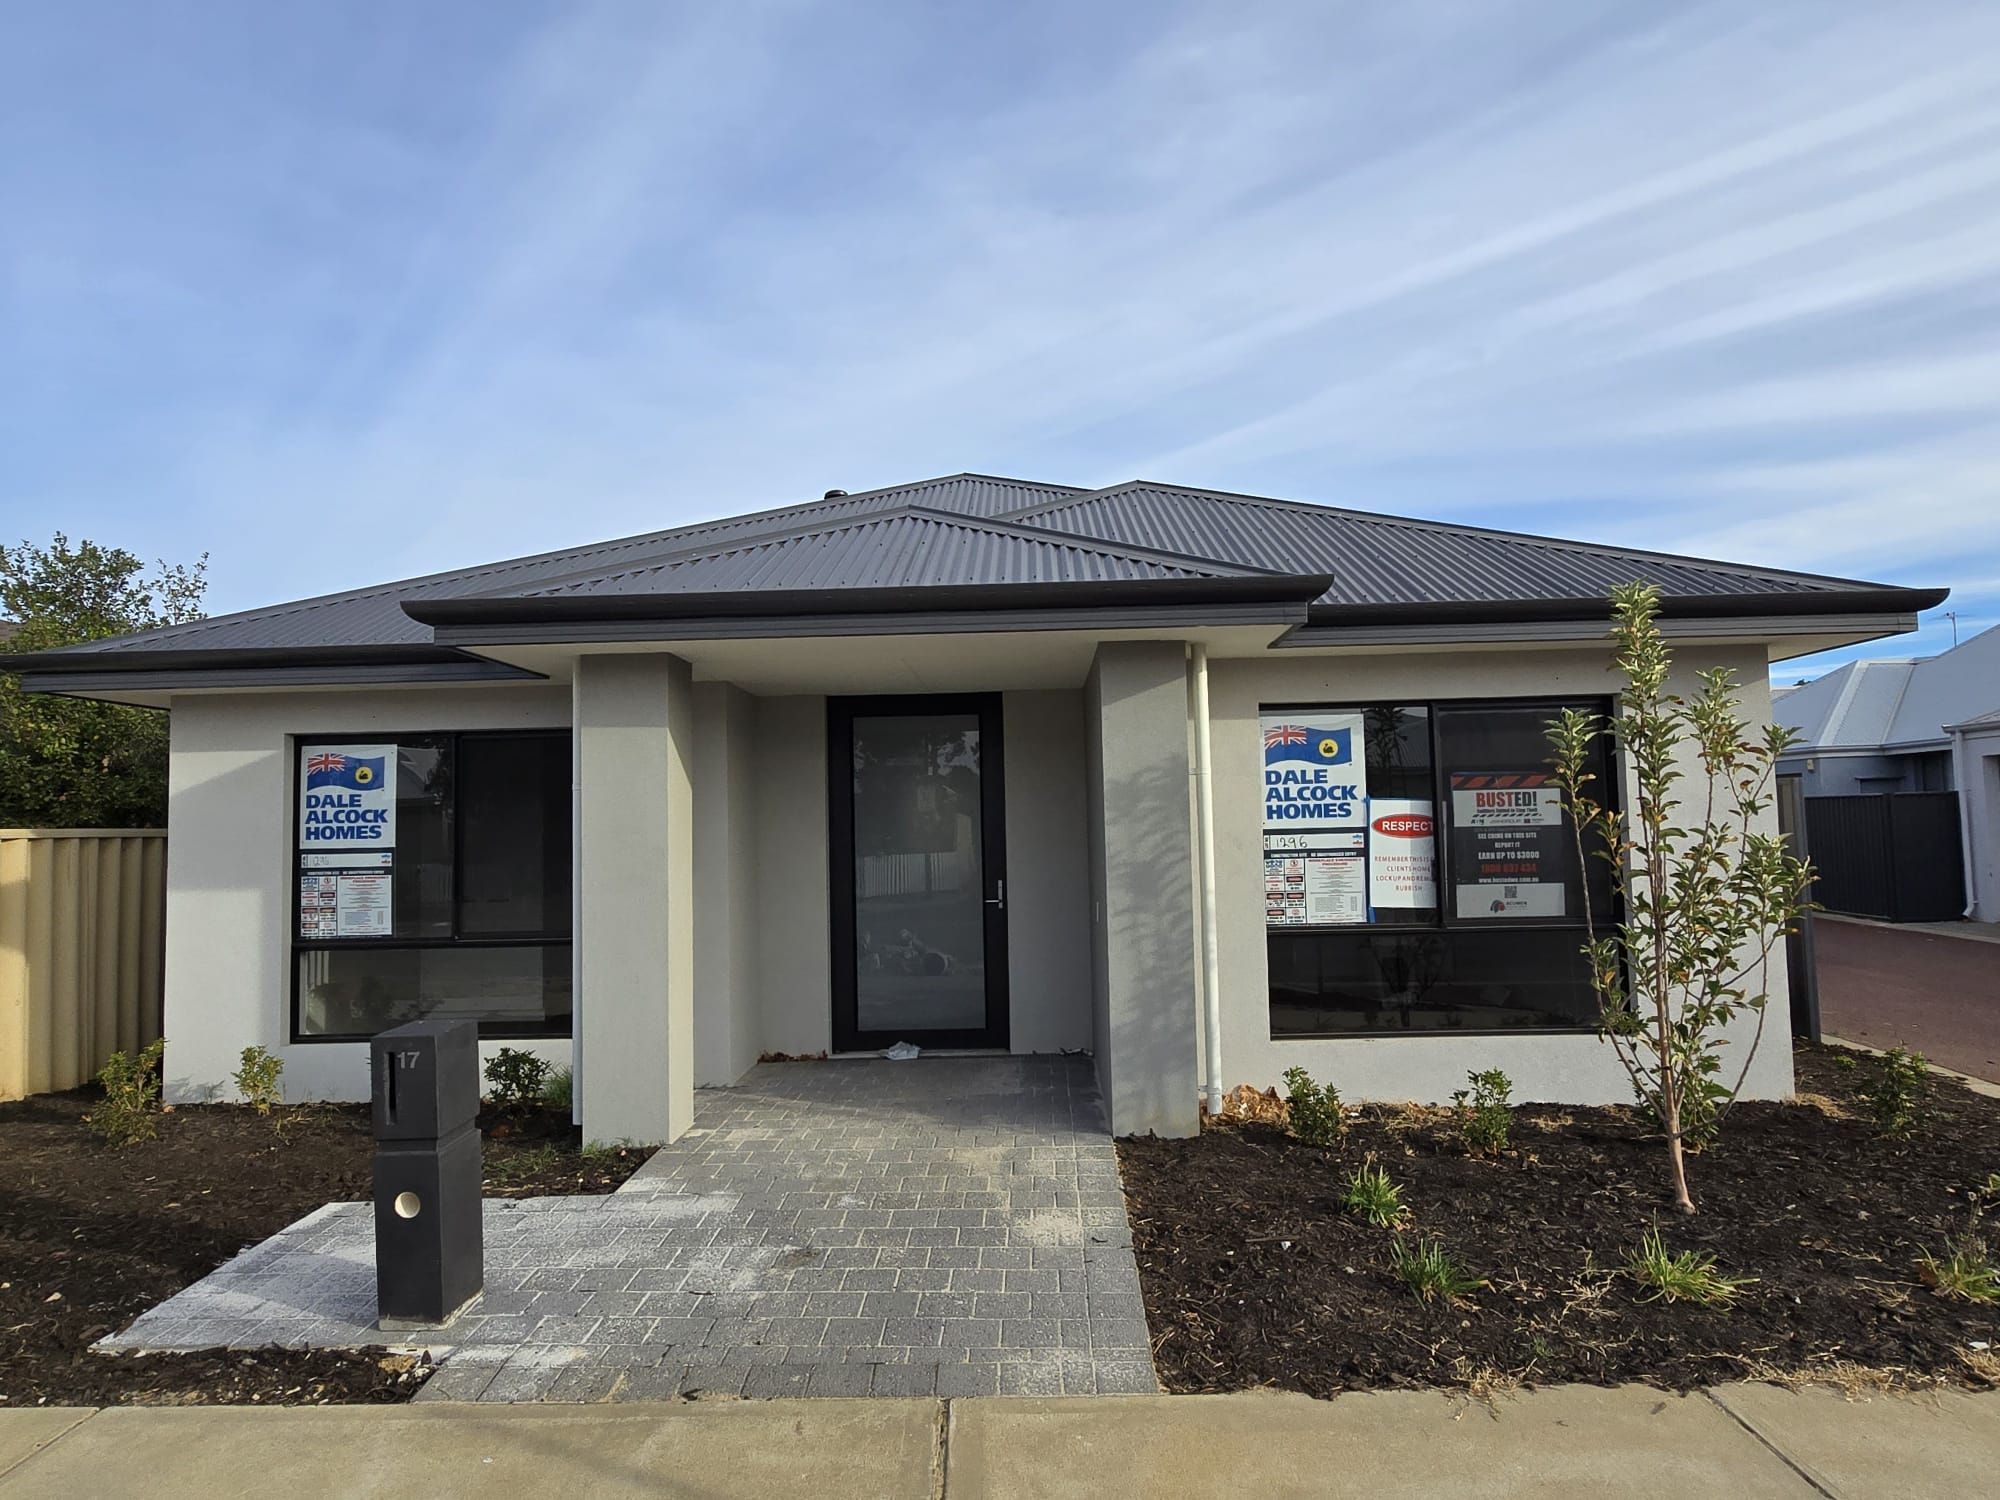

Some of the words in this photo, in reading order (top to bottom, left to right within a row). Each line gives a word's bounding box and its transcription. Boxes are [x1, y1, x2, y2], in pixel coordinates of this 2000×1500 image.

[1265, 769, 1328, 785] DALE
[306, 794, 362, 808] DALE
[1265, 785, 1358, 802] ALCOCK
[1476, 791, 1537, 807] BUSTED!
[305, 809, 388, 824] ALCOCK
[1266, 803, 1352, 820] HOMES
[305, 825, 382, 840] HOMES
[1382, 821, 1433, 831] RESPECT
[1277, 836, 1308, 848] 1296
[1496, 851, 1505, 859] UP
[1506, 851, 1515, 859] TO
[397, 1051, 420, 1069] 17
